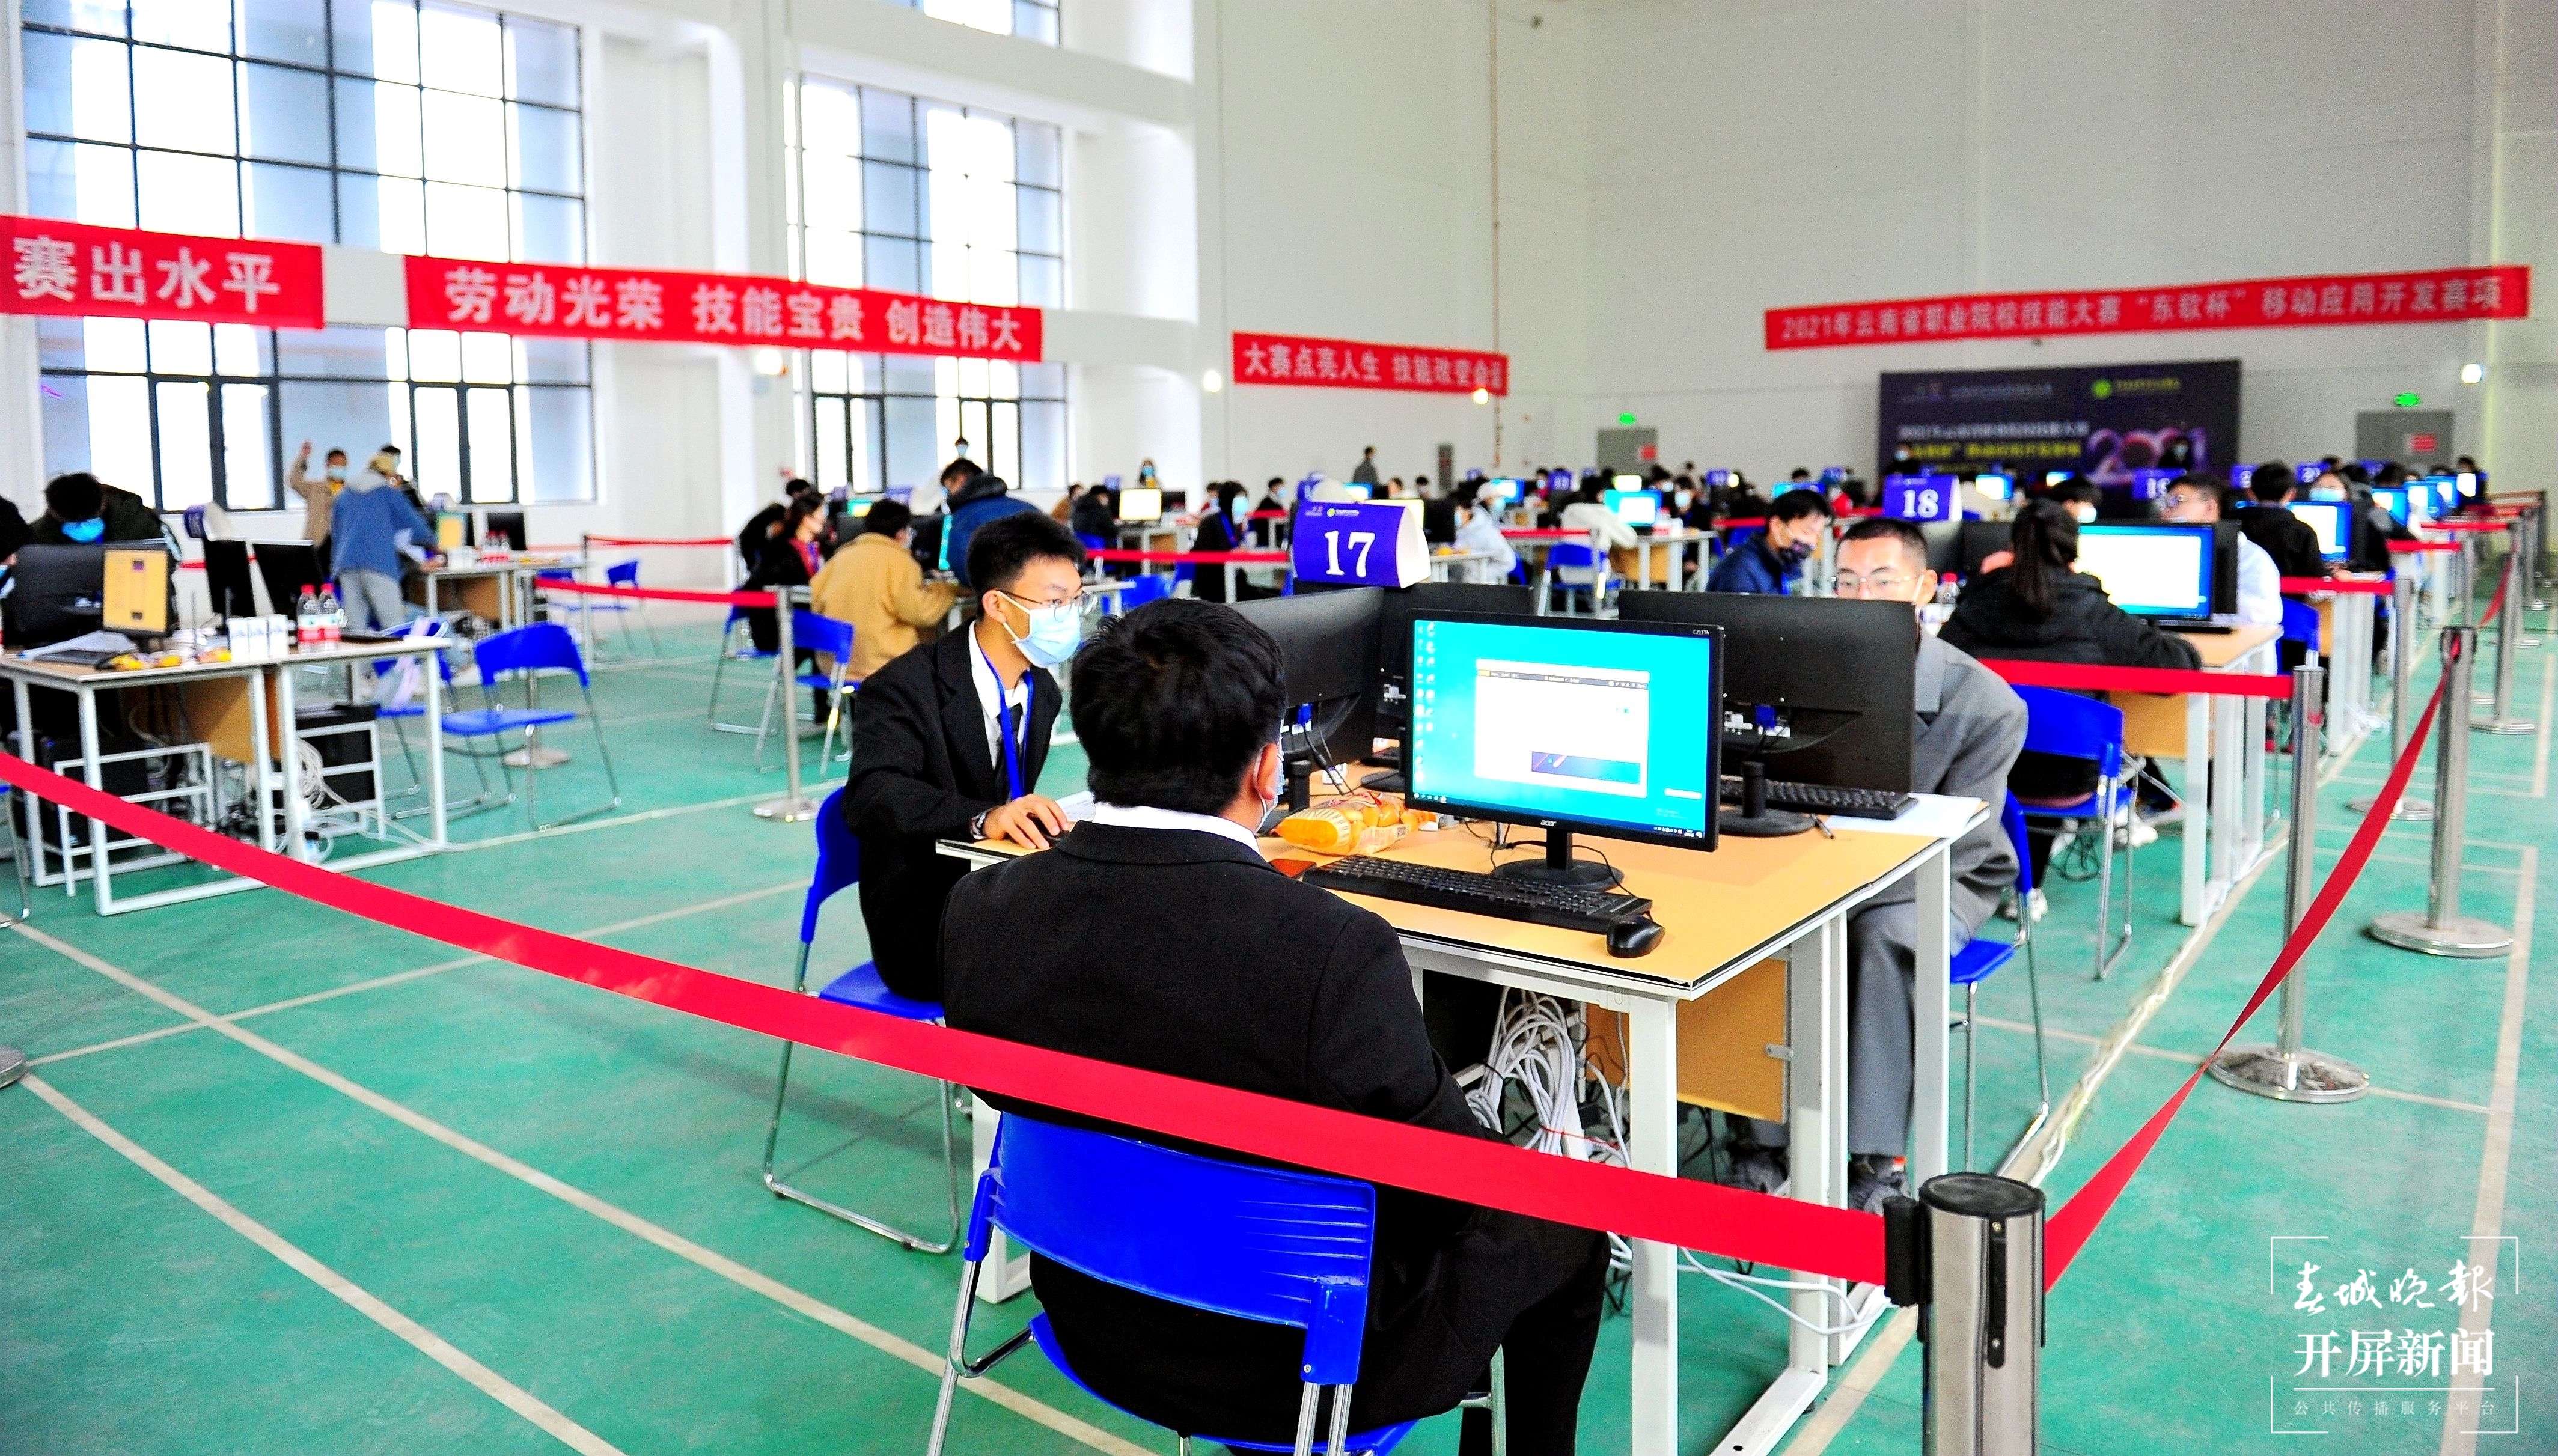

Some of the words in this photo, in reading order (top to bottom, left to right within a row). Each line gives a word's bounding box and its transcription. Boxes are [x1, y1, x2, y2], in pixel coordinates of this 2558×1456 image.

[13, 234, 281, 314] 赛出水平
[444, 265, 664, 331] 劳动光荣
[691, 282, 865, 342] 技能宝贵
[884, 298, 1022, 353] 创造伟大
[1244, 342, 1382, 382] 大赛点亮人生
[1903, 489, 1939, 519] 18
[1324, 530, 1376, 578] 17
